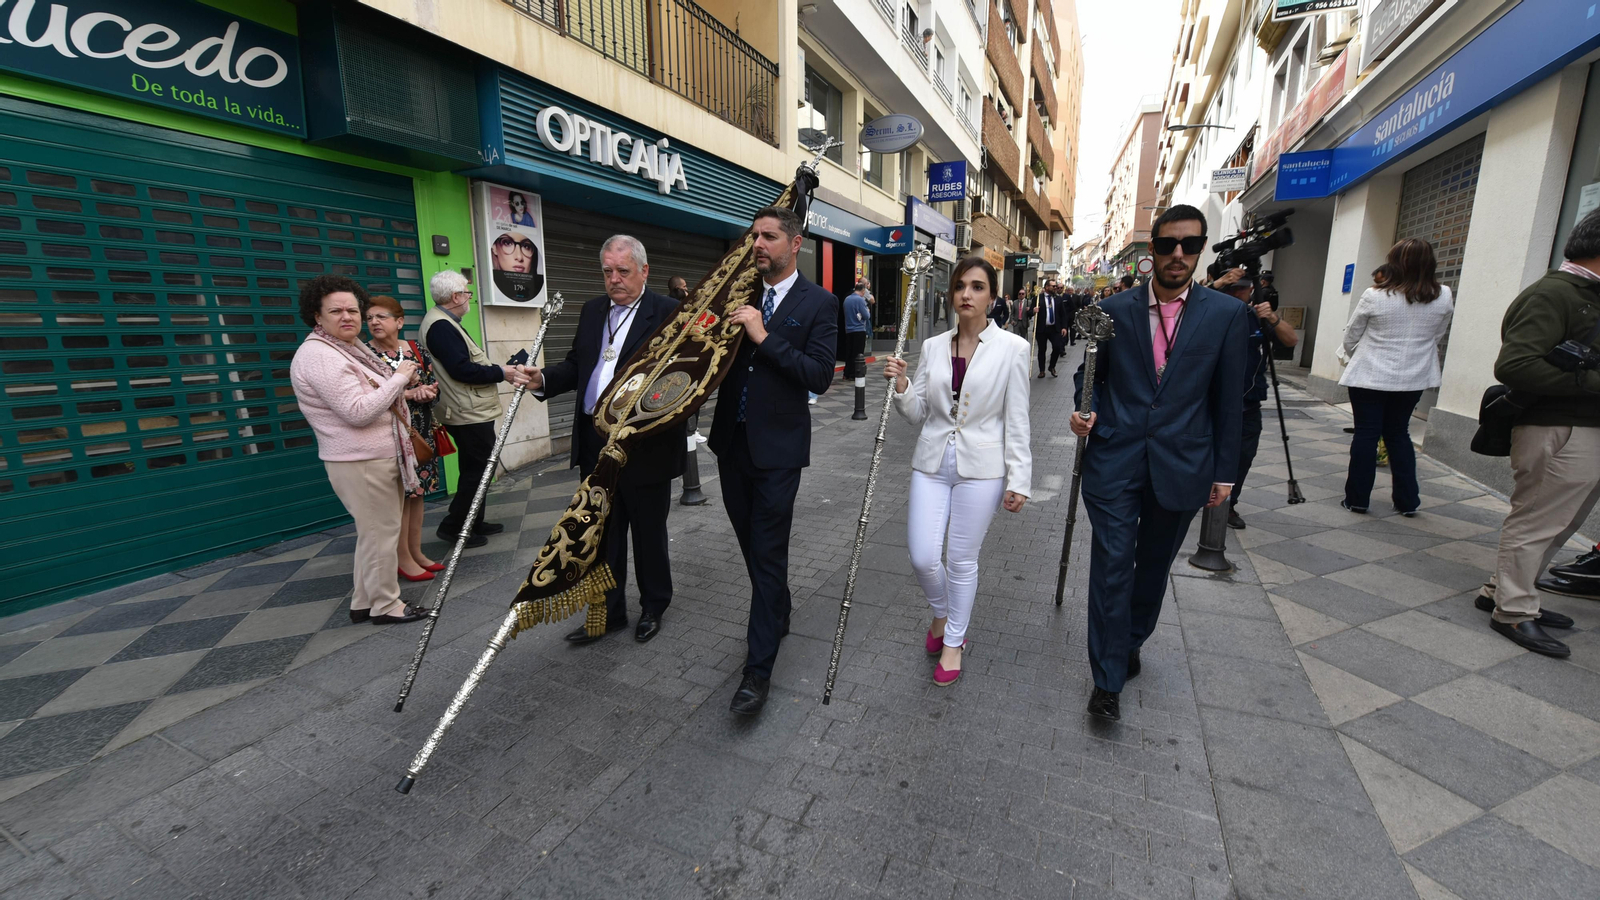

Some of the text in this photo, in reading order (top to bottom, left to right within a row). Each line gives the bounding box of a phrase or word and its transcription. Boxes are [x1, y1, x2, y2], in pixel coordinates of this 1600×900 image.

[0, 0, 288, 88] ucedo
[131, 73, 300, 130] De toda la vida...
[1374, 70, 1456, 146] santalucía
[1393, 123, 1419, 147] SEGUROS
[1282, 159, 1330, 169] santalucía
[931, 181, 963, 192] RUBES
[931, 191, 963, 199] ASESORIA
